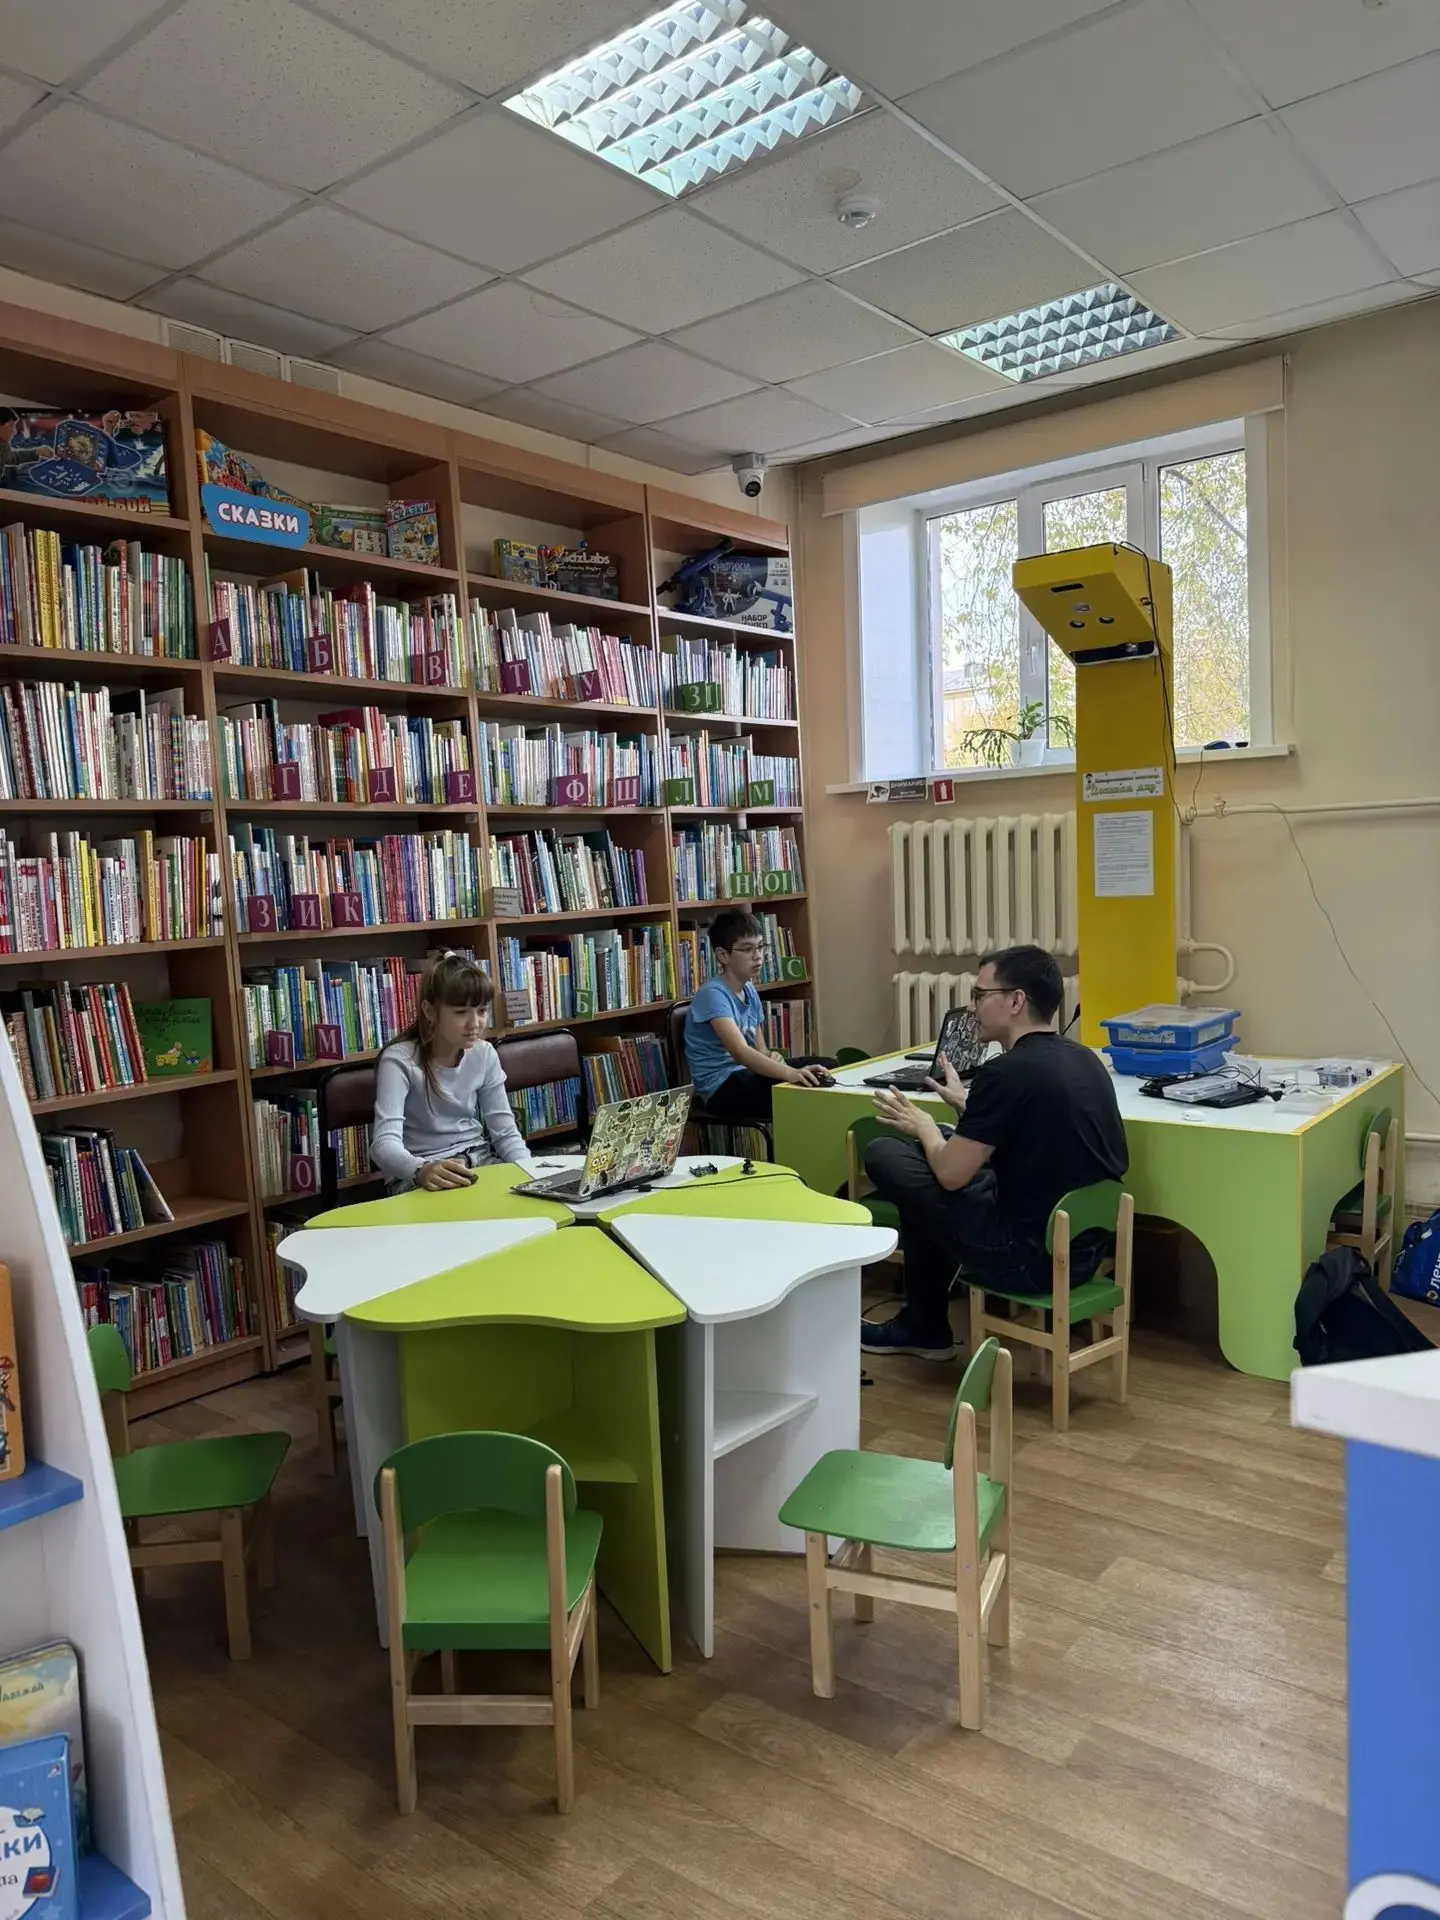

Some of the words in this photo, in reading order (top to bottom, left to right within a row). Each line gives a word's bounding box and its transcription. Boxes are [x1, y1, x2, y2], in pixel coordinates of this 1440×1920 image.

[217, 502, 300, 534] СКАЗКИ
[561, 550, 610, 565] idzLabs
[741, 614, 768, 622] НАБОР
[741, 621, 768, 629] ОГО
[213, 624, 229, 655] А
[313, 638, 329, 667] Б
[429, 654, 442, 680] В
[510, 663, 524, 688] Т
[580, 671, 595, 696] У
[281, 766, 295, 794] Г
[374, 770, 390, 801] Д
[457, 773, 472, 799] Е
[565, 779, 585, 801] Ф
[617, 778, 638, 801] Ш
[674, 780, 690, 801] Л
[752, 783, 770, 802] М
[735, 875, 751, 894] Н
[764, 873, 780, 892] О
[257, 898, 270, 927] З
[299, 899, 319, 927] И
[342, 895, 360, 922] К
[787, 958, 801, 977] С
[576, 991, 589, 1013] Б
[274, 1035, 290, 1062] Л
[318, 1028, 338, 1054] М
[295, 1160, 312, 1188] О
[0, 1832, 42, 1863] КИ
